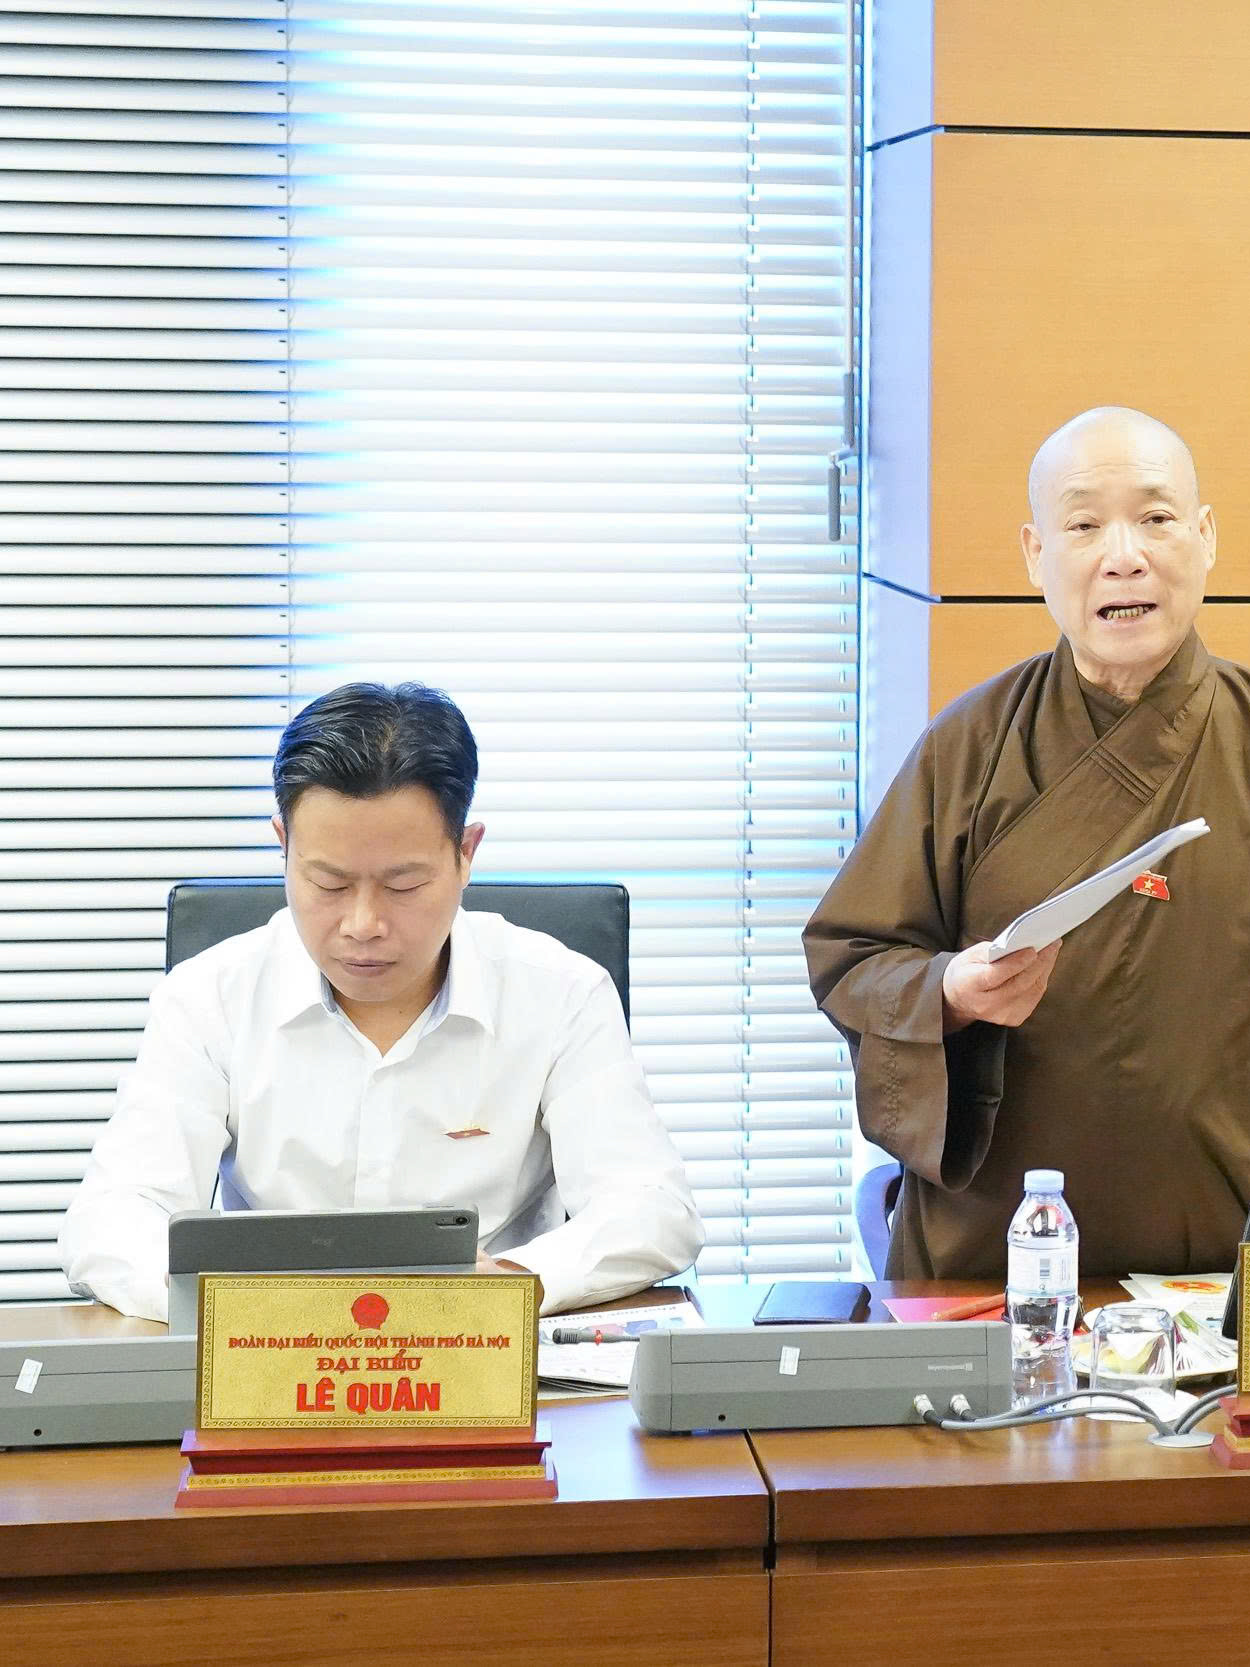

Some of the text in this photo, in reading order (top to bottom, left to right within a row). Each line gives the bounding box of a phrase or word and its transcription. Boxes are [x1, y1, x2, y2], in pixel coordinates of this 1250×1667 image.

[228, 1334, 266, 1349] ĐOÀN
[267, 1337, 291, 1350] ĐẠI
[325, 1333, 363, 1350] QUỐC
[364, 1334, 389, 1350] HỘI
[390, 1333, 435, 1348] THÀNH
[437, 1333, 465, 1348] PHỐ
[465, 1334, 485, 1348] HÀ
[487, 1334, 511, 1350] NỘI
[316, 1348, 423, 1375] ĐẠI BIỂU
[296, 1376, 441, 1416] LÊ QUÂN
